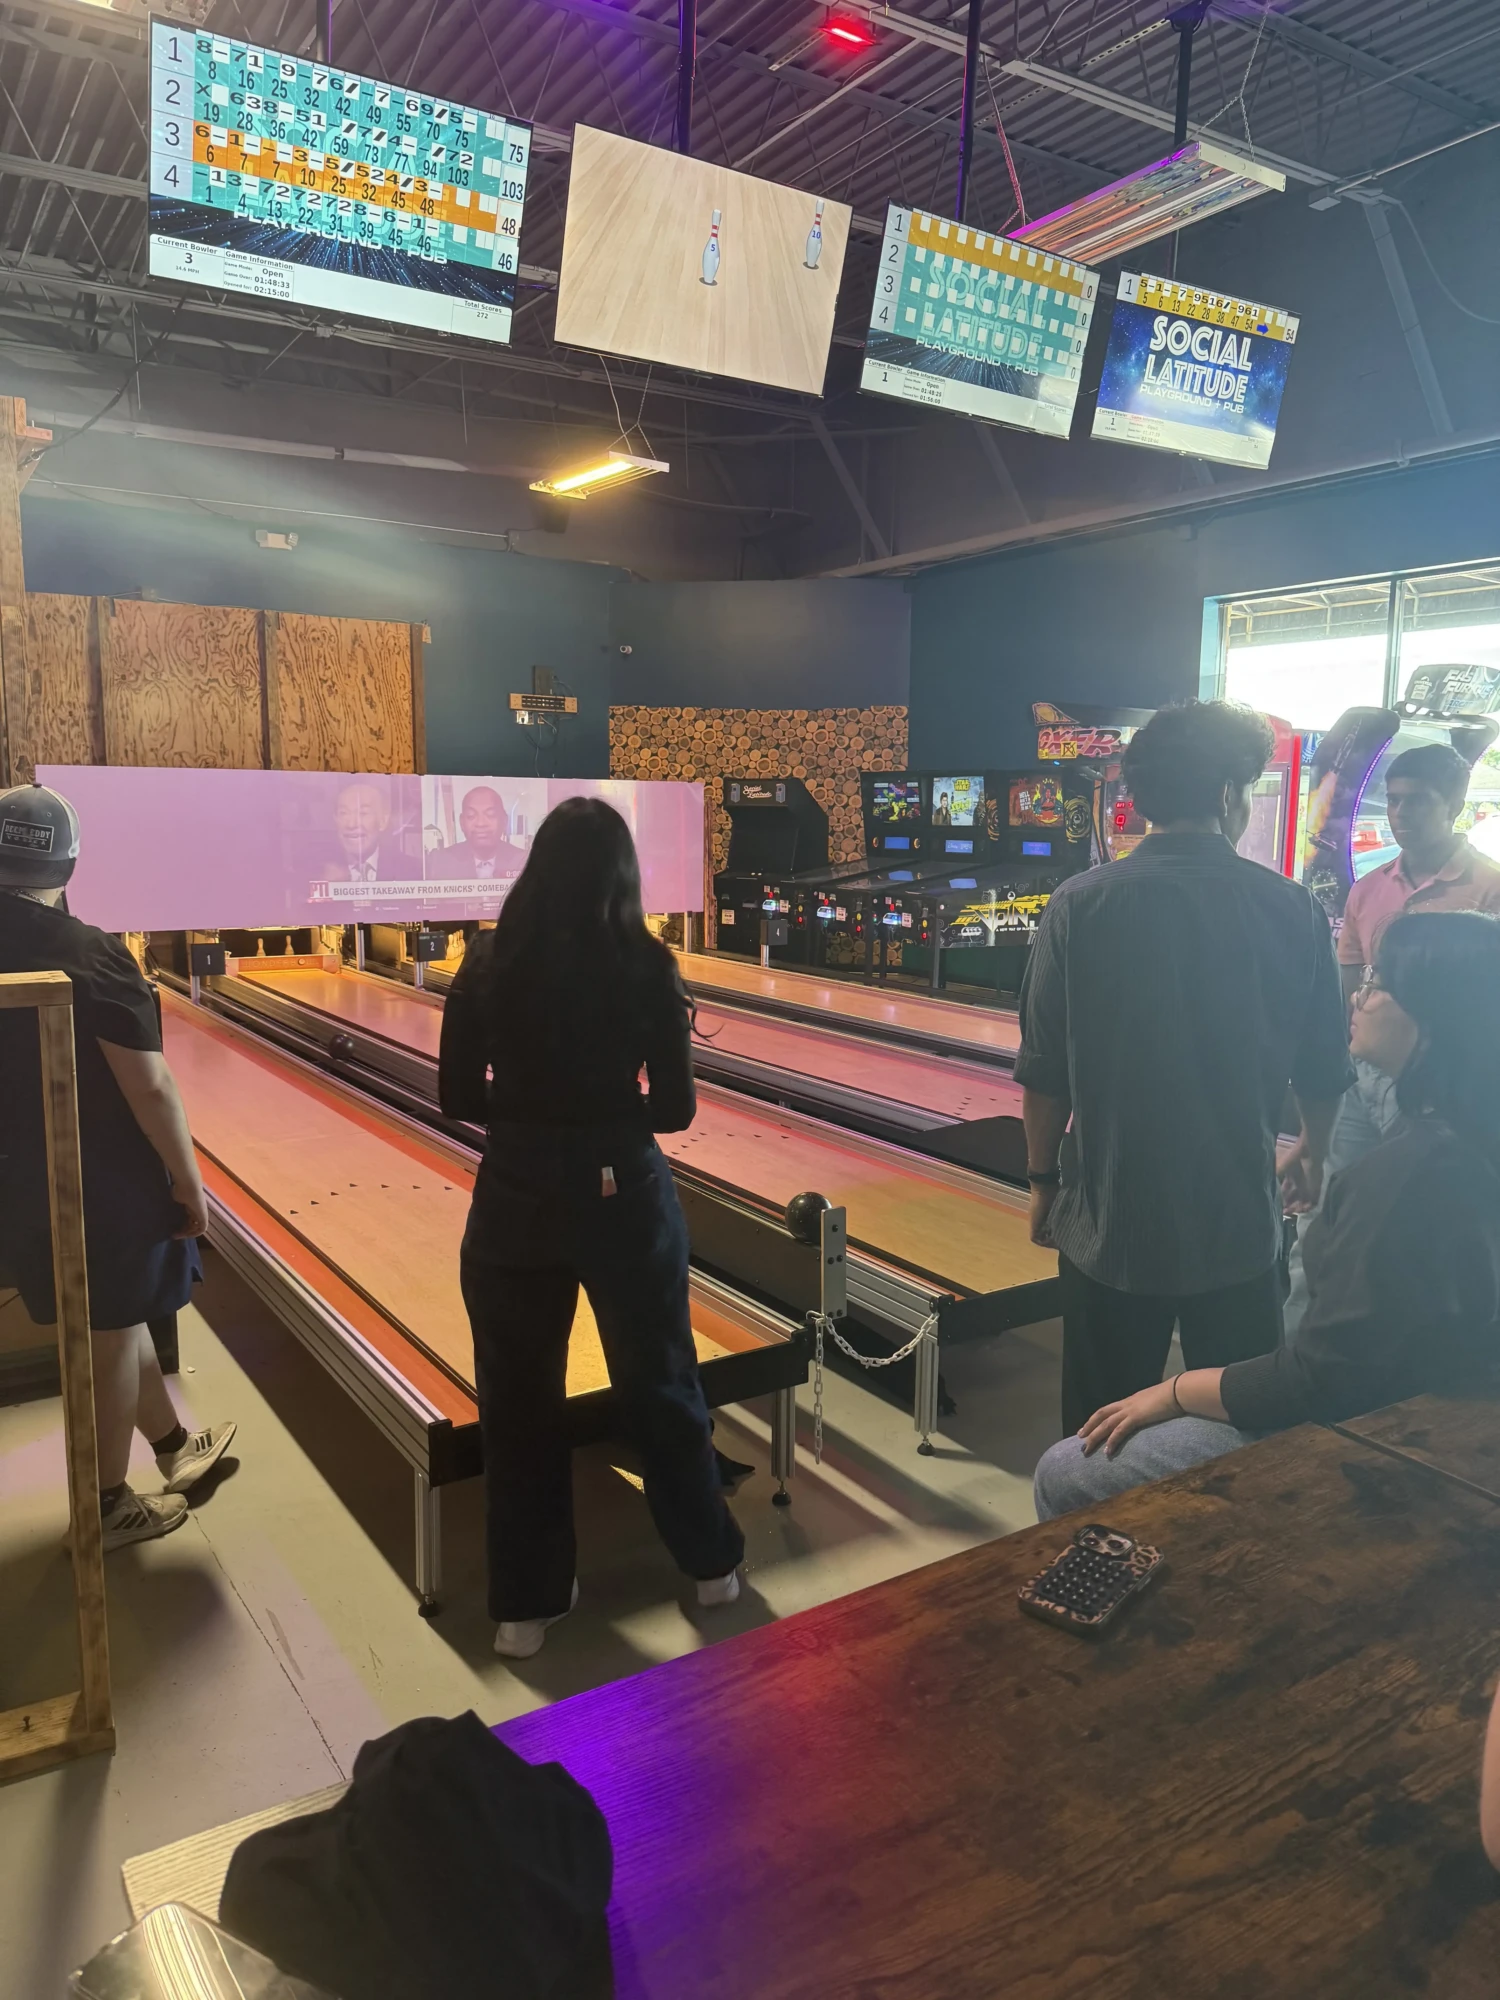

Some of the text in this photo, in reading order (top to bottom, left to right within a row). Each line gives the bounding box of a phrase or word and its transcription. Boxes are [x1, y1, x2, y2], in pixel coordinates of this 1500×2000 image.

[168, 37, 182, 63] 1
[166, 79, 180, 105] 2
[208, 61, 524, 163] 8 16 25 32 42 49 55 70 75 75
[165, 122, 179, 146] 3
[203, 102, 523, 200] 19 28 36 42 59 73 77 94 103 103
[164, 165, 179, 187] 4
[206, 144, 516, 236] 6 7 7 10 25 32 45 48 48
[205, 185, 513, 271] 1 4 13 22 31 39 45 46 46
[894, 214, 903, 233] 1
[811, 230, 821, 240] 10
[157, 236, 218, 255] Current Bowler
[407, 244, 448, 265] PUB
[710, 243, 716, 252] 5
[888, 244, 899, 263] 2
[184, 253, 193, 264] 3
[225, 251, 294, 271] Game Information
[254, 276, 290, 289] 01:48:33
[262, 268, 284, 279] Open
[254, 286, 290, 298] 02:15:00
[883, 275, 894, 293] 3
[1125, 279, 1132, 295] 1
[926, 259, 1045, 329] SOCIAL
[464, 300, 502, 314] Total Scores
[476, 311, 489, 319] 272
[879, 306, 889, 324] 4
[920, 301, 1043, 365] LATITUDE
[1150, 315, 1252, 372] SOCIAL
[915, 335, 1040, 377] PLAYGROUND PUB
[882, 372, 888, 383] 1
[1143, 354, 1249, 403] LATITUDE
[1140, 384, 1244, 413] PLAYGROUND PUB
[333, 887, 370, 896] BIGGEST
[372, 886, 415, 895] TAKEAWAY
[417, 886, 441, 894] FROM
[443, 885, 475, 893] KNICKS'
[430, 941, 435, 951] 2
[207, 954, 211, 965] 1
